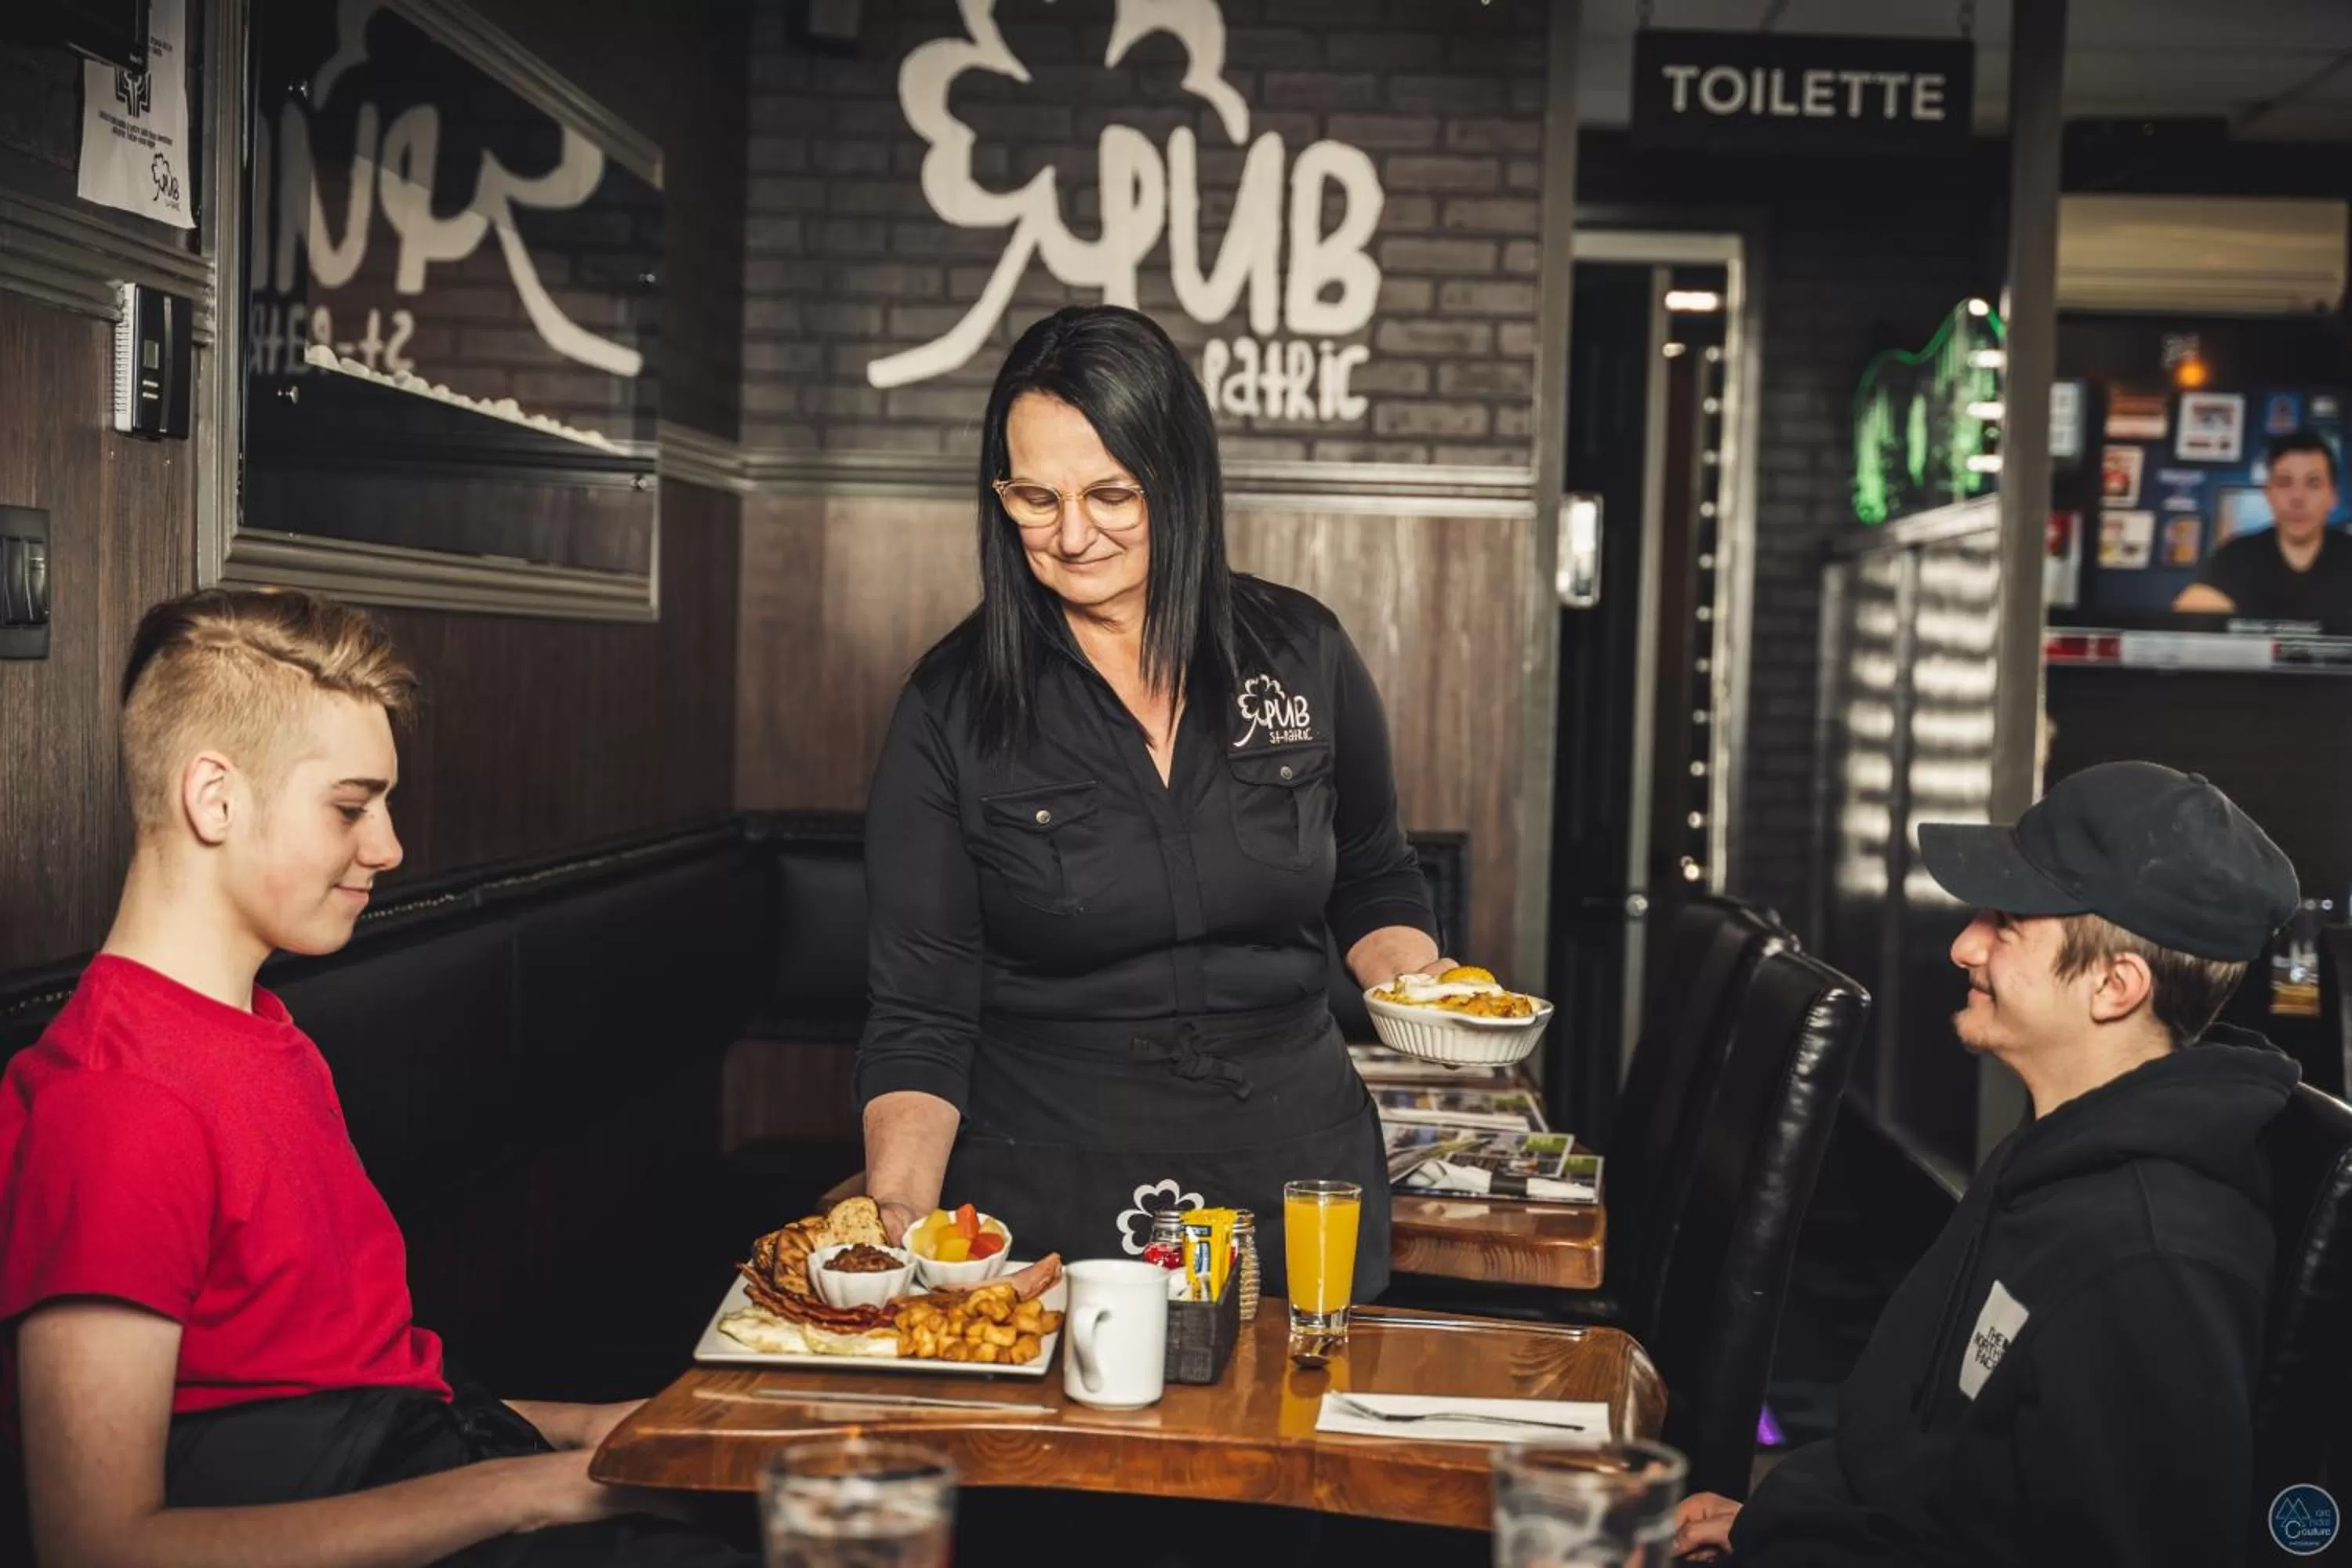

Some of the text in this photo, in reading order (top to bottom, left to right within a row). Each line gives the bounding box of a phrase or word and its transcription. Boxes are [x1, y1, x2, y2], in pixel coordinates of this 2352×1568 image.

[1661, 64, 1947, 121] TOILETTE
[1099, 124, 1385, 336] PUB
[1263, 695, 1310, 729] PUB
